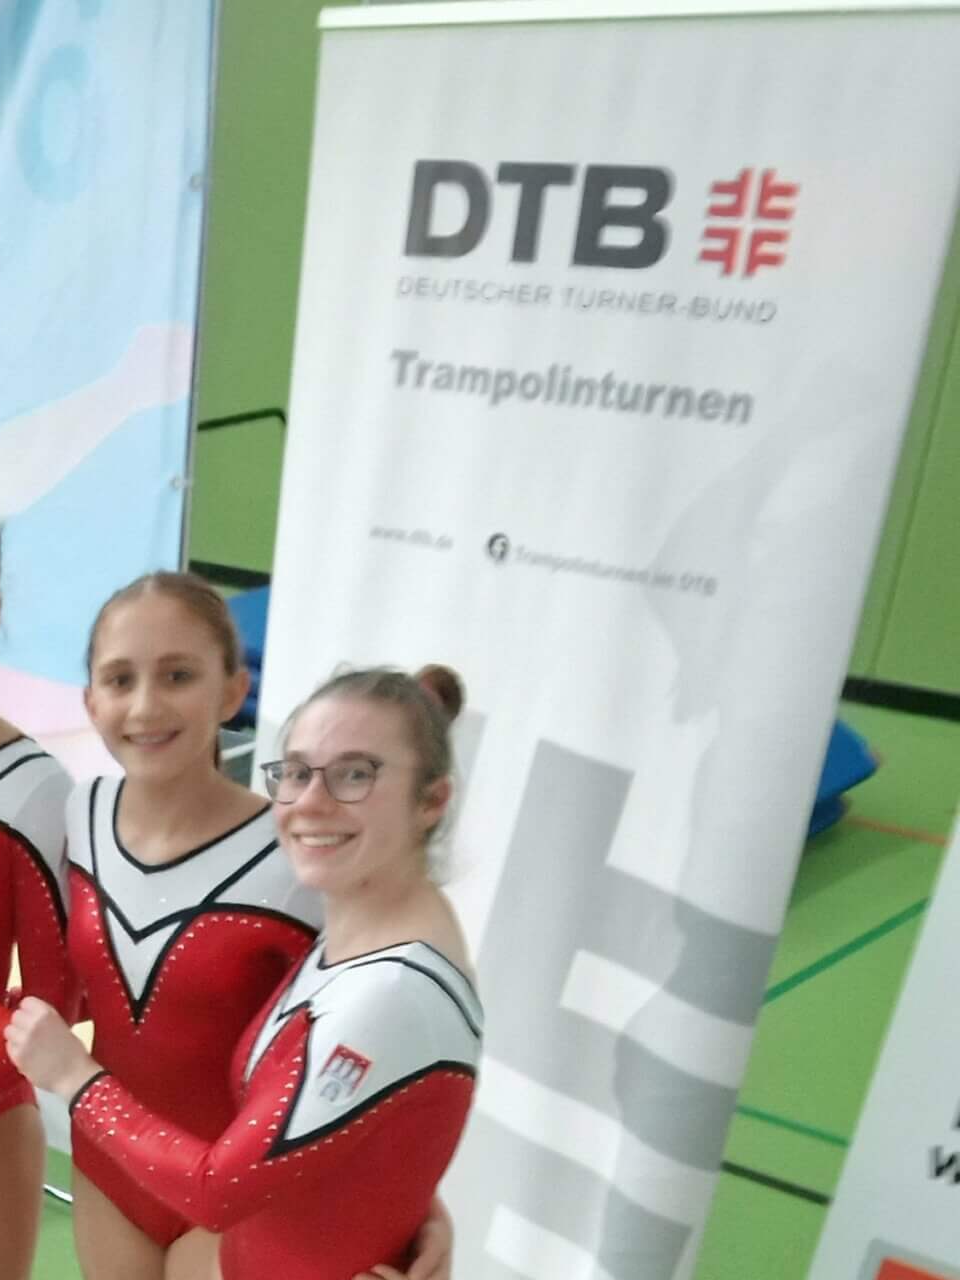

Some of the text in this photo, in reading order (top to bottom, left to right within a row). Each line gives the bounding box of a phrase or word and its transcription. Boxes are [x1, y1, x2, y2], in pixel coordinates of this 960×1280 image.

[403, 159, 677, 270] DTB
[396, 274, 778, 324] DEUTSCHER TURNER-BUND
[390, 348, 755, 426] Trampolinturnen
